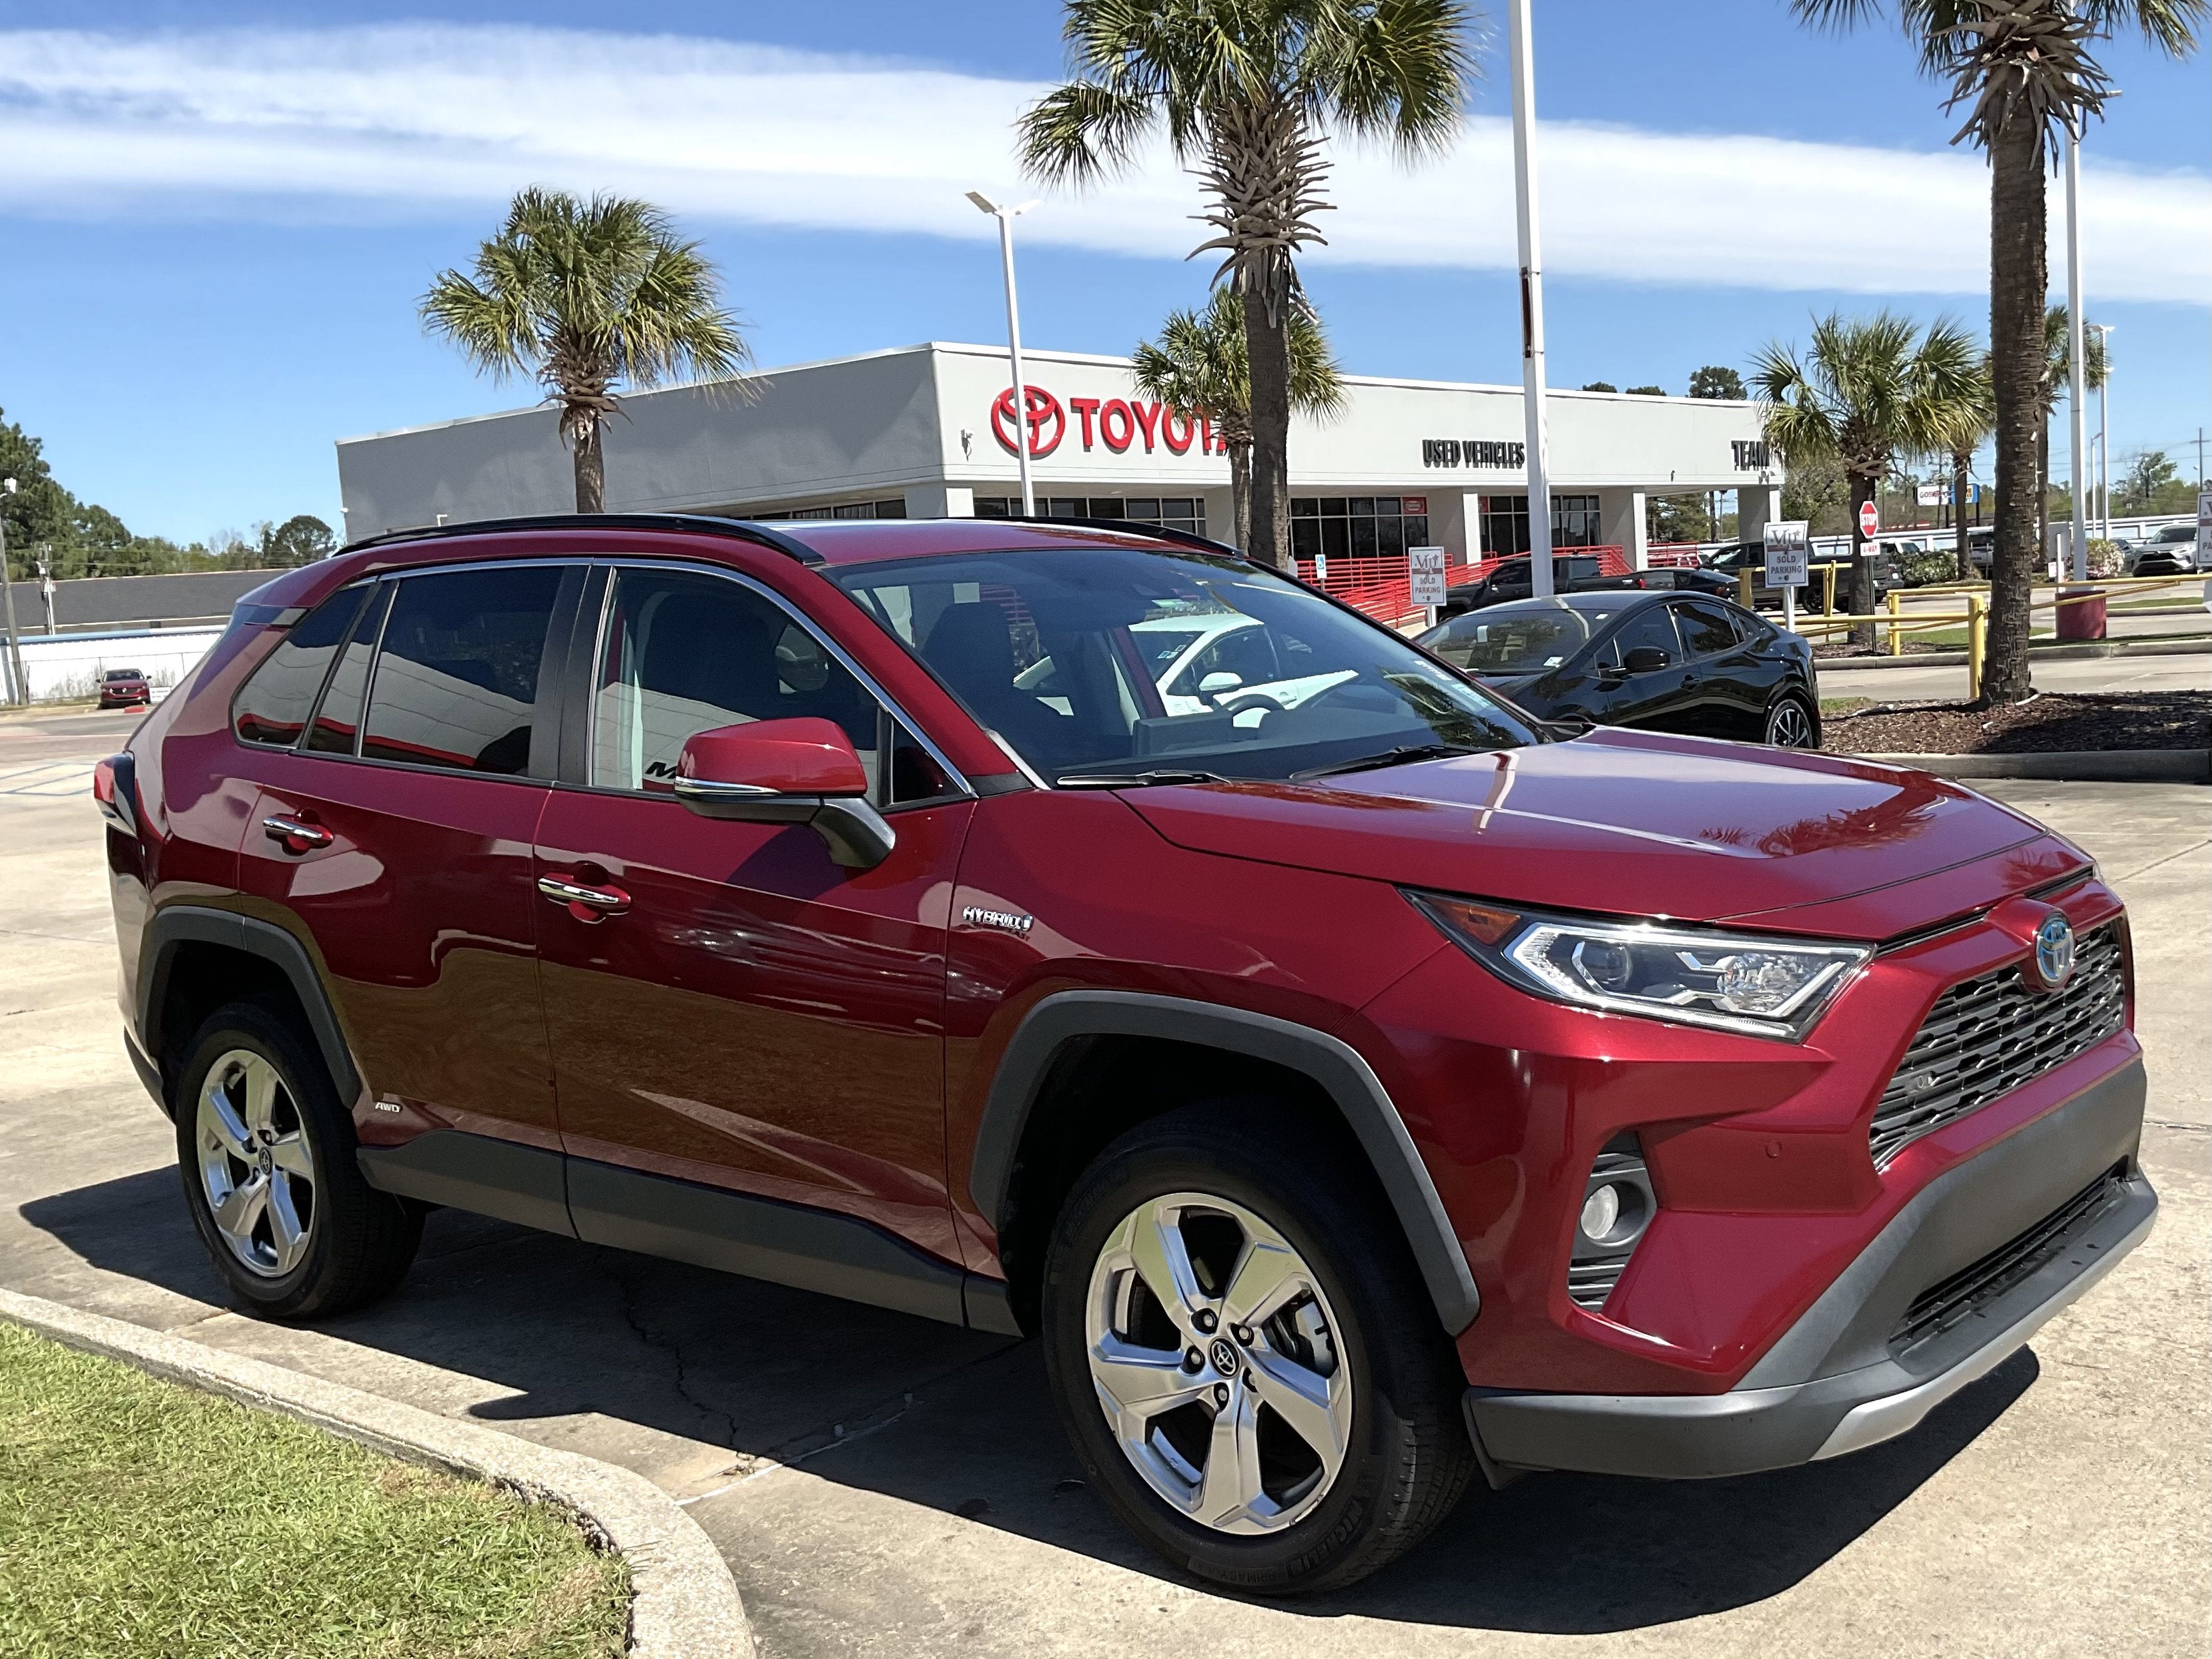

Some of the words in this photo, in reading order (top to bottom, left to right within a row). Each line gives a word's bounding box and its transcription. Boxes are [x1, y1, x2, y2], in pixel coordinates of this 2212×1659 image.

[1070, 398, 1226, 450] TOYOT
[1422, 439, 1461, 465] USED
[1462, 440, 1525, 466] VEHICLES
[1731, 440, 1770, 468] TEAM
[1862, 513, 1876, 526] STOP
[1777, 555, 1796, 563] SOLD
[1771, 565, 1802, 574] PARKING
[963, 906, 1022, 930] HYBRID
[375, 1102, 400, 1112] AWD
